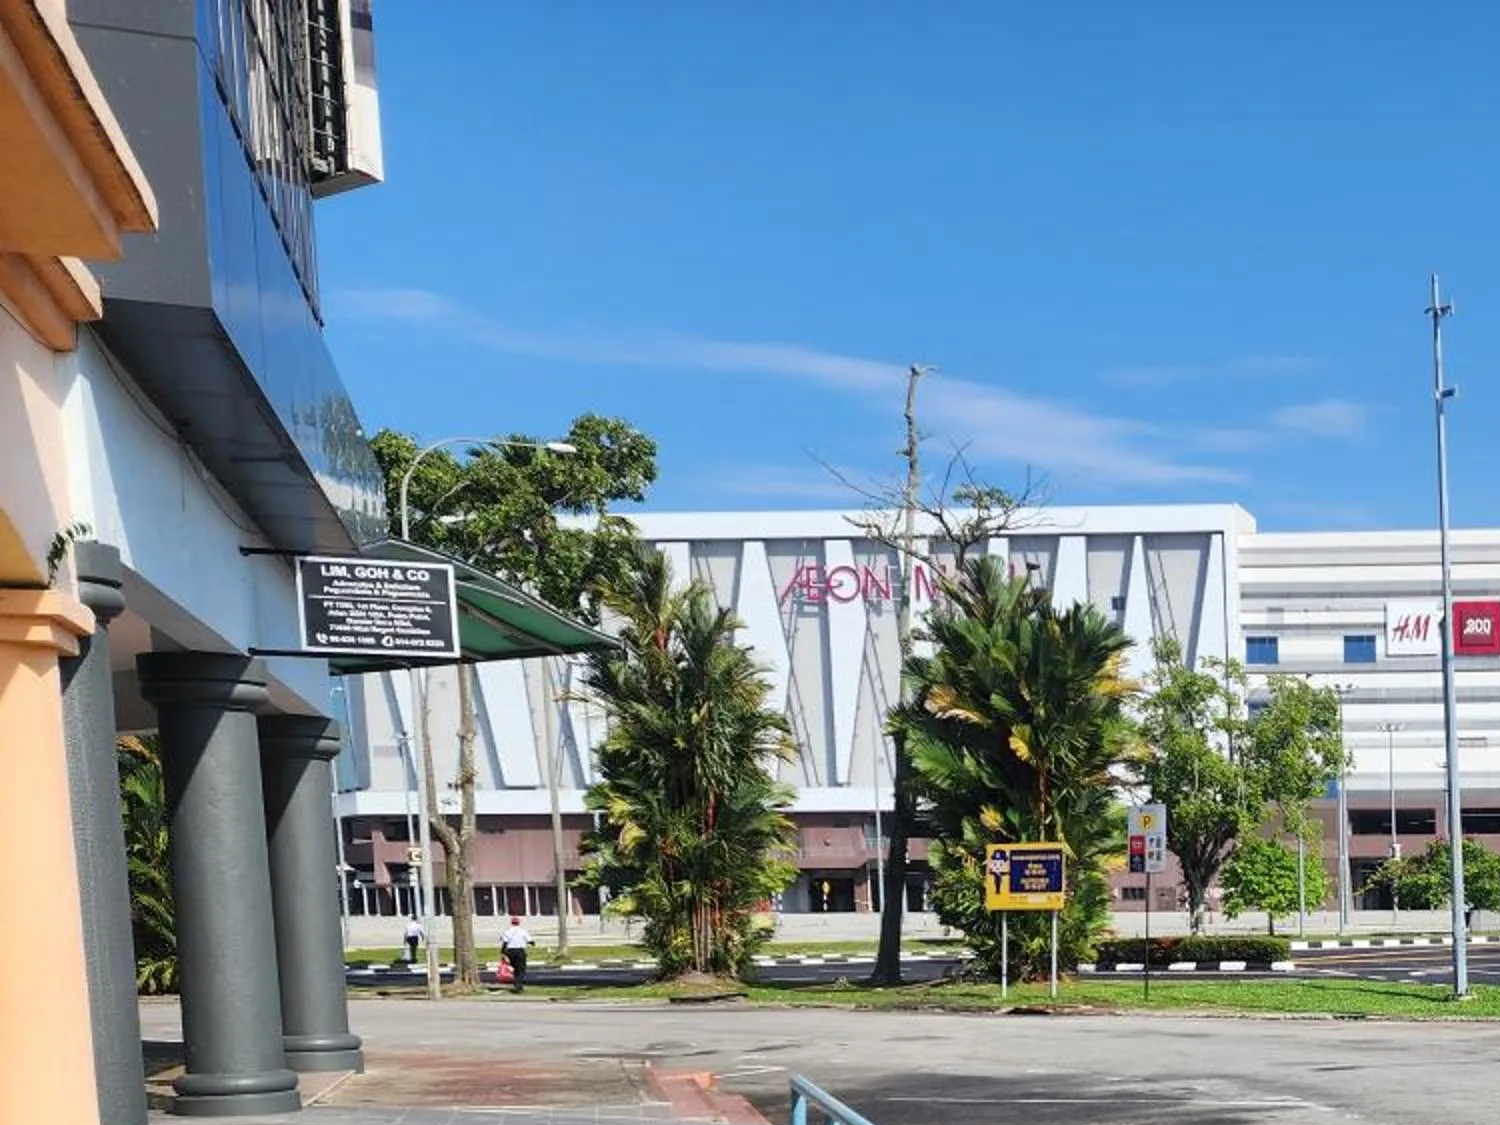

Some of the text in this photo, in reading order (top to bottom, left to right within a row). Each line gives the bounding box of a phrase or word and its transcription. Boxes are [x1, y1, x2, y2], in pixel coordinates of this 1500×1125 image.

[321, 565, 431, 581] LIM, GOH & CO
[1391, 614, 1431, 642] H&M
